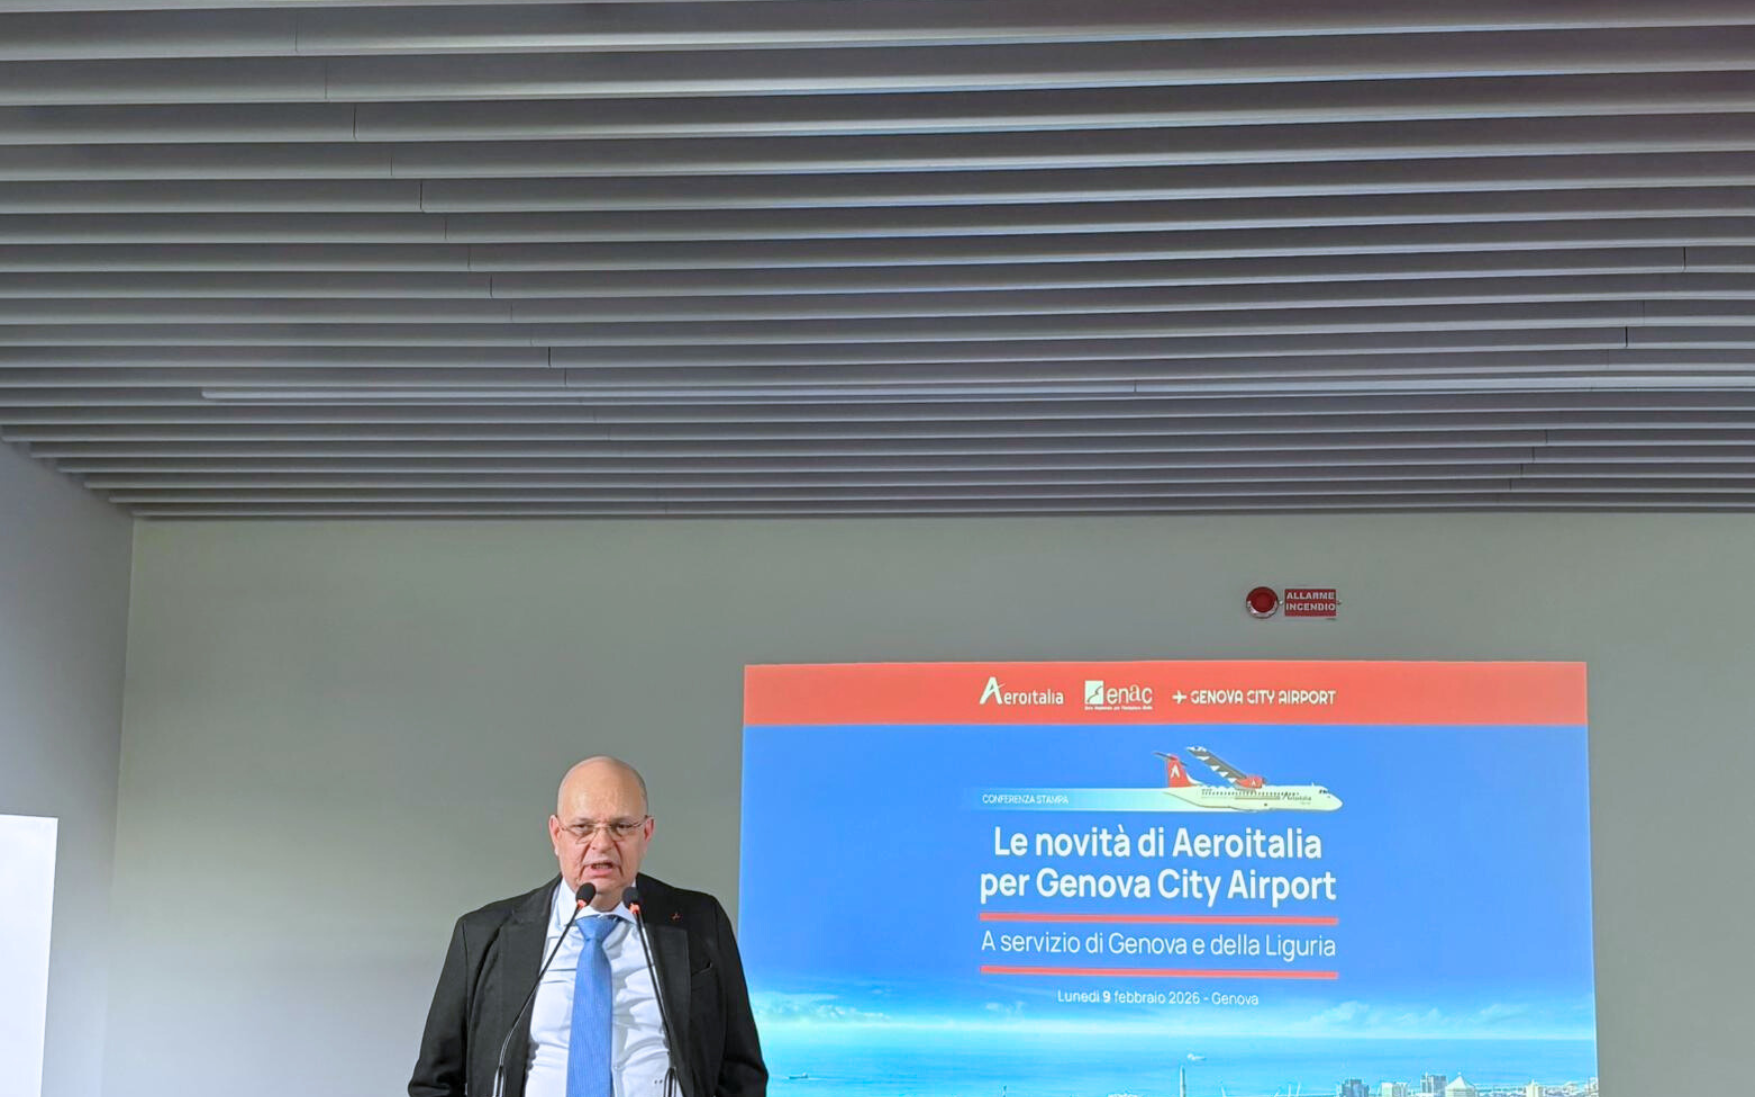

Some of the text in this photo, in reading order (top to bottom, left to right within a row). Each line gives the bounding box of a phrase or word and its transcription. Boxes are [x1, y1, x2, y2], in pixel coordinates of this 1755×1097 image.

[1286, 592, 1335, 600] ALLARME
[1285, 602, 1336, 611] INCENDIO
[979, 676, 1065, 705] Aeroitalia
[1106, 684, 1153, 705] enac
[1190, 689, 1336, 705] GENOVA CITY AIRPORT
[982, 794, 1069, 804] CONFERENZA STAMPA
[994, 824, 1322, 859] Le novità di Aeroitalia
[980, 867, 1337, 908] per Genova City Airport
[981, 930, 1337, 963] A servizio di Genova e della Liguria
[1102, 990, 1111, 1004] 9
[1114, 989, 1166, 1004] febbraio
[1168, 990, 1201, 1005] 2026
[1211, 991, 1259, 1006] Genova
